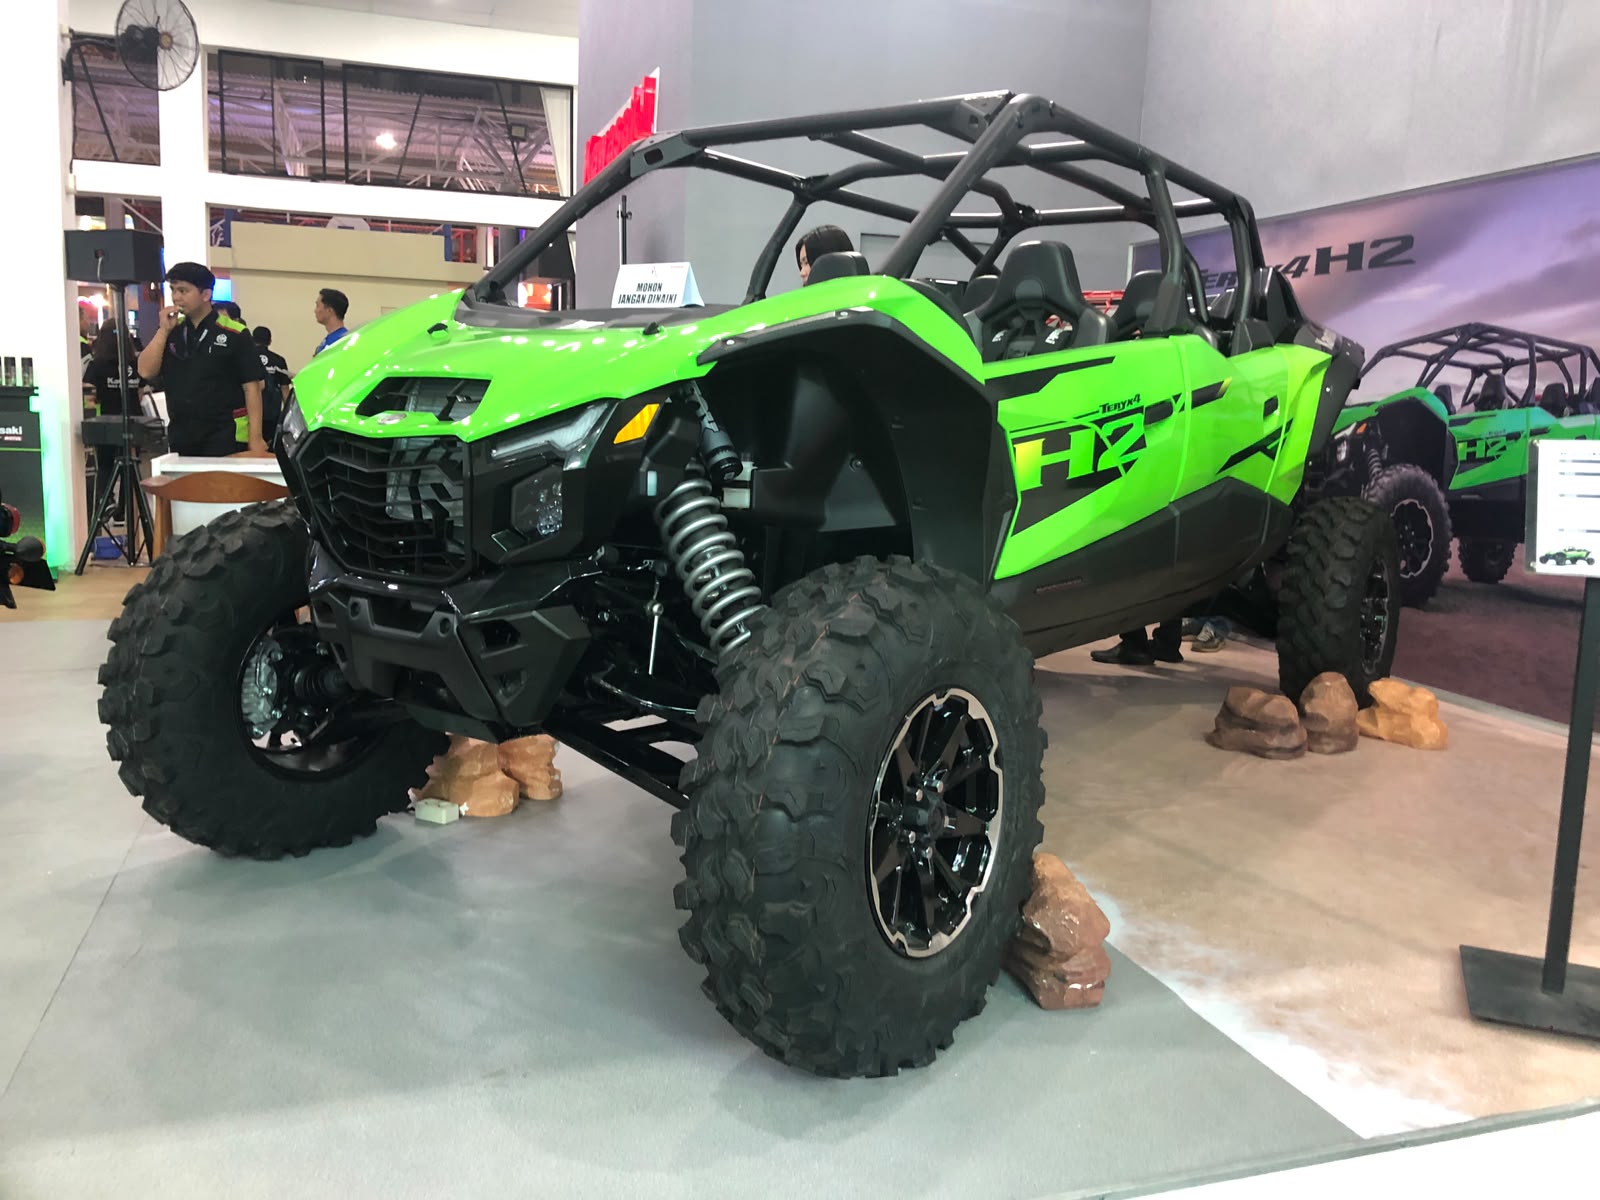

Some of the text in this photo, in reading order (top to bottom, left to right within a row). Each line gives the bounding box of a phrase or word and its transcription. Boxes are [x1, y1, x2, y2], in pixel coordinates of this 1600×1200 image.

[1314, 234, 1416, 277] H2
[618, 294, 678, 305] JANGAN DINAIKI
[636, 282, 663, 293] MOHON
[1014, 412, 1147, 492] H2
